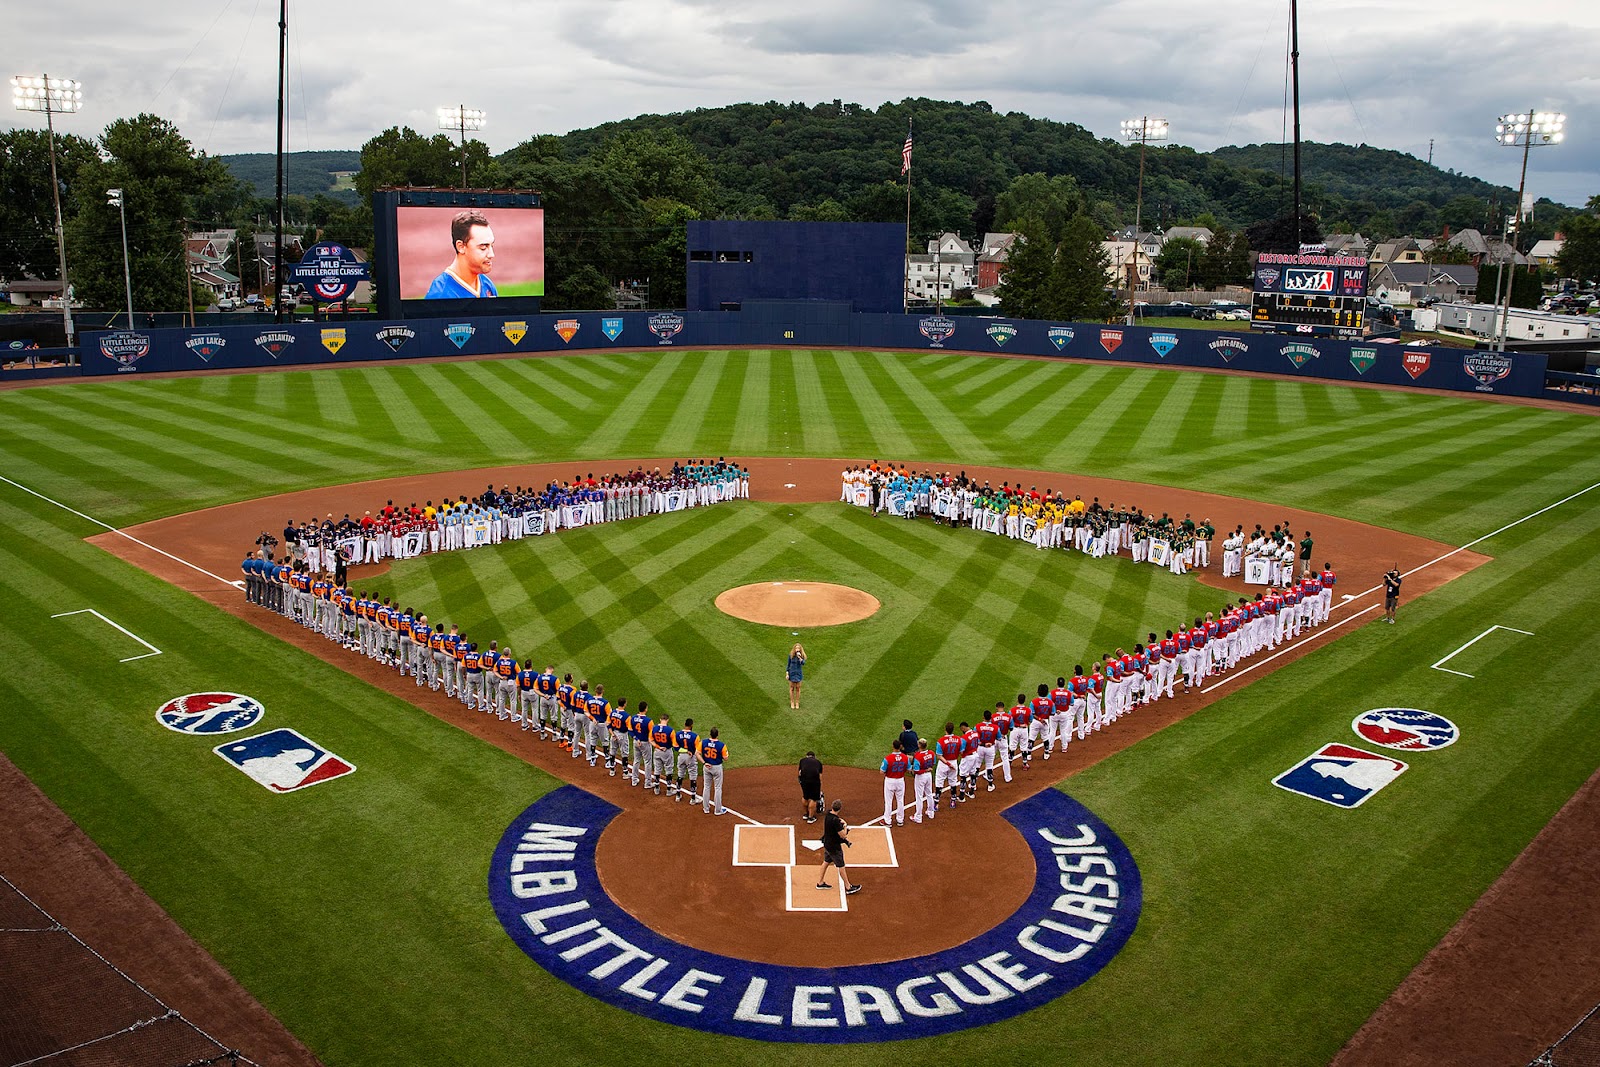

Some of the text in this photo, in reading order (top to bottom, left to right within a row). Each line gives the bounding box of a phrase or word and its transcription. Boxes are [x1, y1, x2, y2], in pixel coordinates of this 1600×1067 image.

[1258, 253, 1367, 267] HISTORIC BOWMAN FIELD
[295, 268, 364, 276] LITTLE LEAGUE CLASSIC
[1344, 270, 1364, 280] PLAY
[1343, 279, 1363, 288] BALL
[1285, 298, 1290, 306] 0
[1307, 299, 1312, 307] 0
[375, 328, 416, 341] NEW ENGLAND
[443, 326, 476, 337] NORTHWEST
[986, 326, 1018, 336] ASIA-PACIFIC
[1048, 328, 1074, 340] AUSTRALIA
[1101, 332, 1122, 340] CANADA
[185, 336, 227, 349] GREAT LAKES
[254, 334, 296, 346] MID-ATLANTIC
[1148, 336, 1179, 346] CARIBBEAN
[1208, 340, 1249, 354] EUROPE-AFRICA
[1280, 345, 1321, 359] LATIN AMERICA
[1352, 350, 1376, 360] MEXICO
[1406, 355, 1427, 364] JAPAN
[1486, 358, 1510, 366] LEAGUE
[417, 632, 428, 642] 45
[466, 660, 477, 669] 20
[524, 678, 530, 686] 6
[542, 680, 549, 690] 9
[590, 704, 600, 716] 21
[611, 717, 622, 729] 30
[636, 722, 642, 734] 4
[654, 732, 668, 744] 68
[684, 738, 688, 749] 1
[947, 743, 956, 754] 17
[704, 746, 718, 760] 36
[892, 762, 906, 772] 22
[510, 822, 1121, 1028] MLB LITTLE LEAGUE CLASSIC
